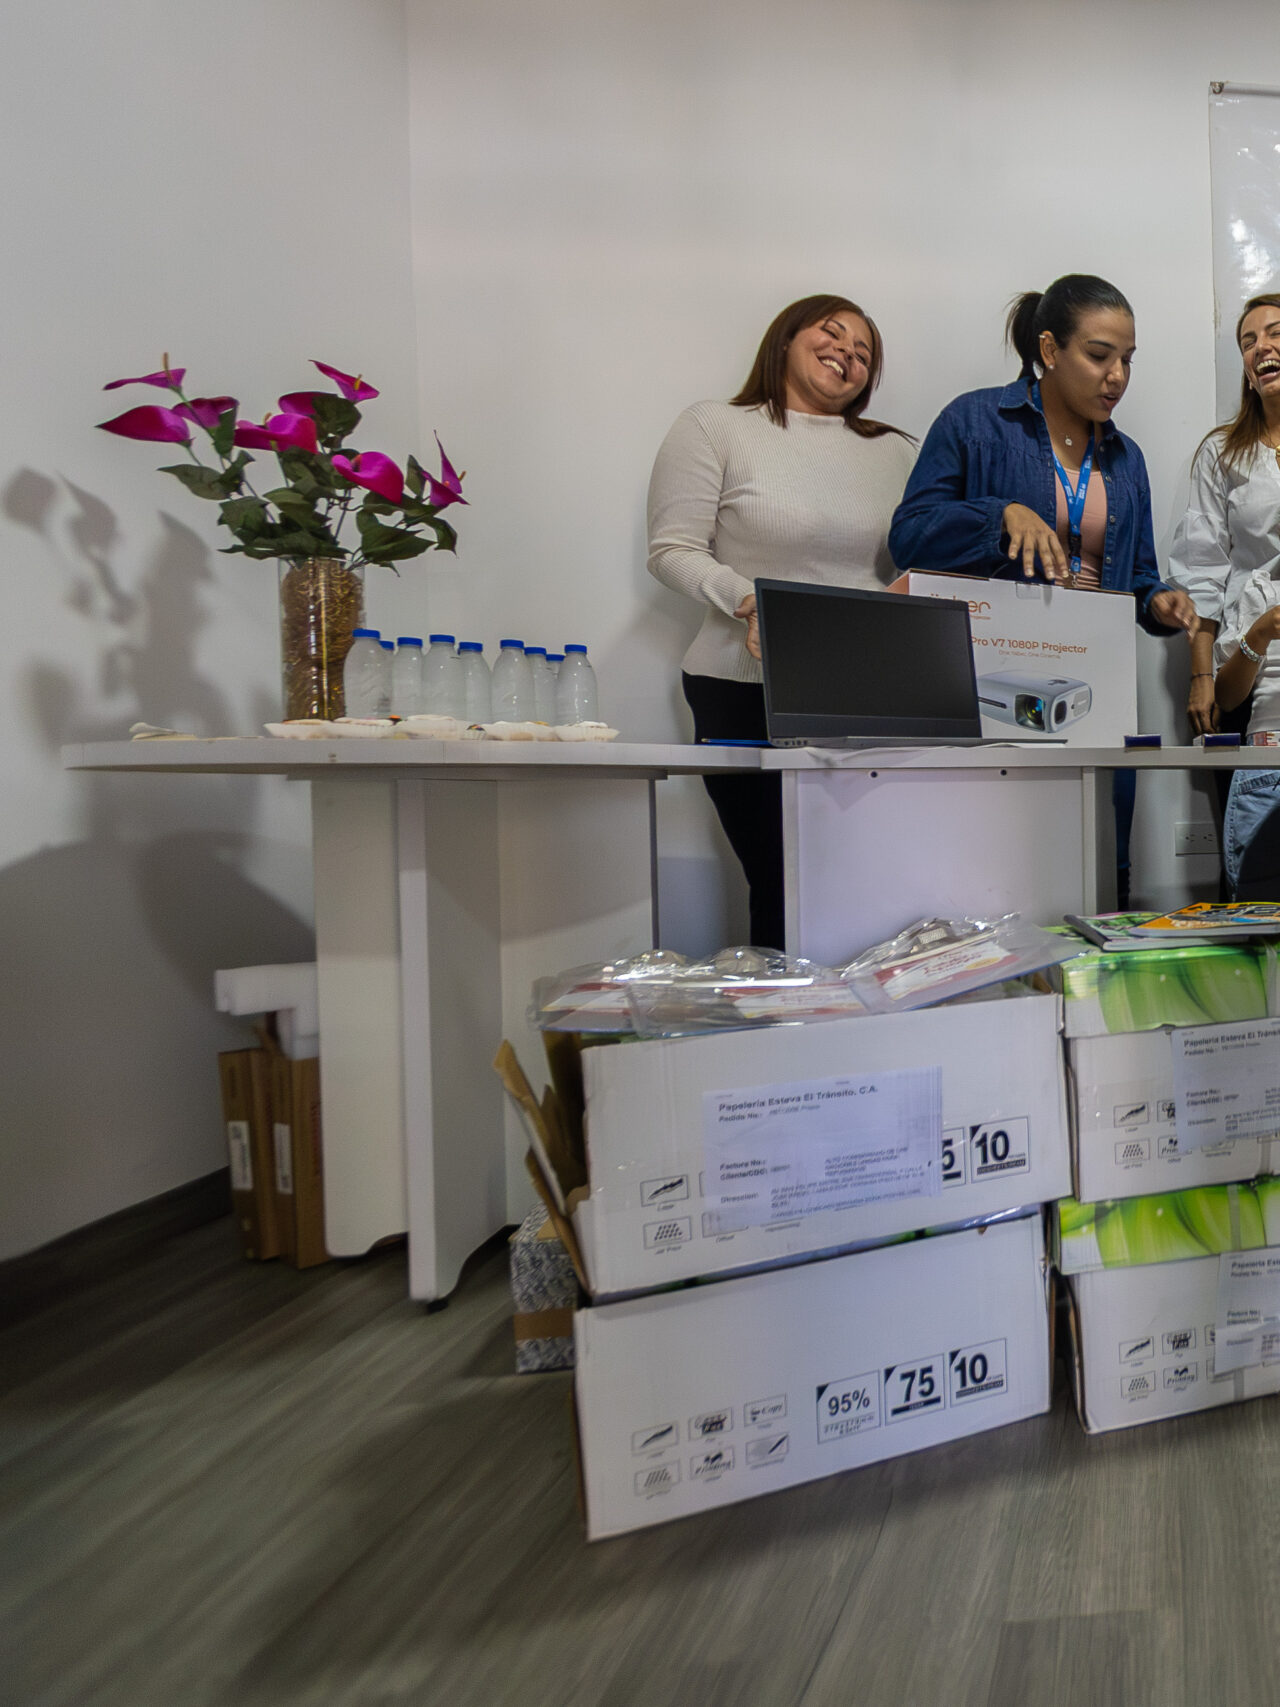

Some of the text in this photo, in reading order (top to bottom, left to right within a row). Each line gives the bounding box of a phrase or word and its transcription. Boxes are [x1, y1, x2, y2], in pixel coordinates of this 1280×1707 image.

[991, 638, 1005, 648] V7
[1008, 640, 1039, 650] 1080P
[1042, 642, 1088, 654] Projector
[975, 1130, 1009, 1165] 10
[898, 1364, 935, 1403] 75
[953, 1352, 988, 1388] 10
[827, 1387, 871, 1417] 95%
